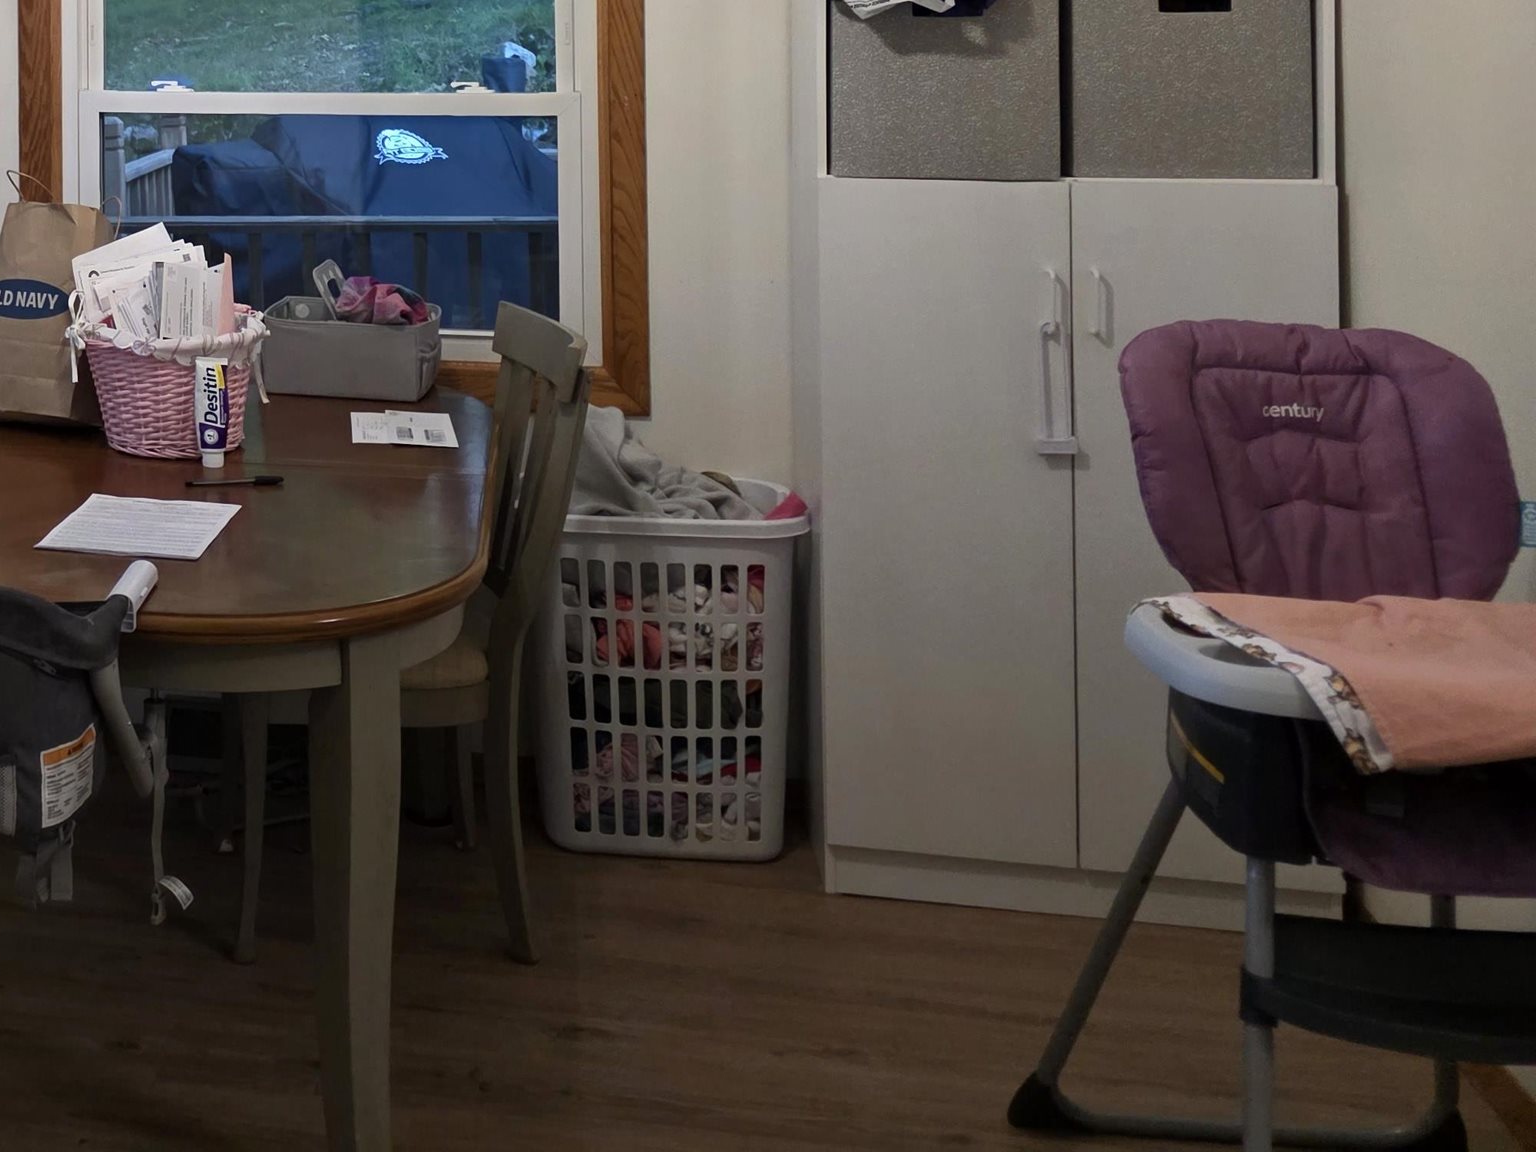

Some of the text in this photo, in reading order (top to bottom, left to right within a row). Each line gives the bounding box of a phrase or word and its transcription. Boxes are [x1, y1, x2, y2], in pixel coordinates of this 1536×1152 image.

[15, 291, 59, 310] NAVY
[202, 367, 218, 425] Desitin
[1262, 402, 1324, 422] century
